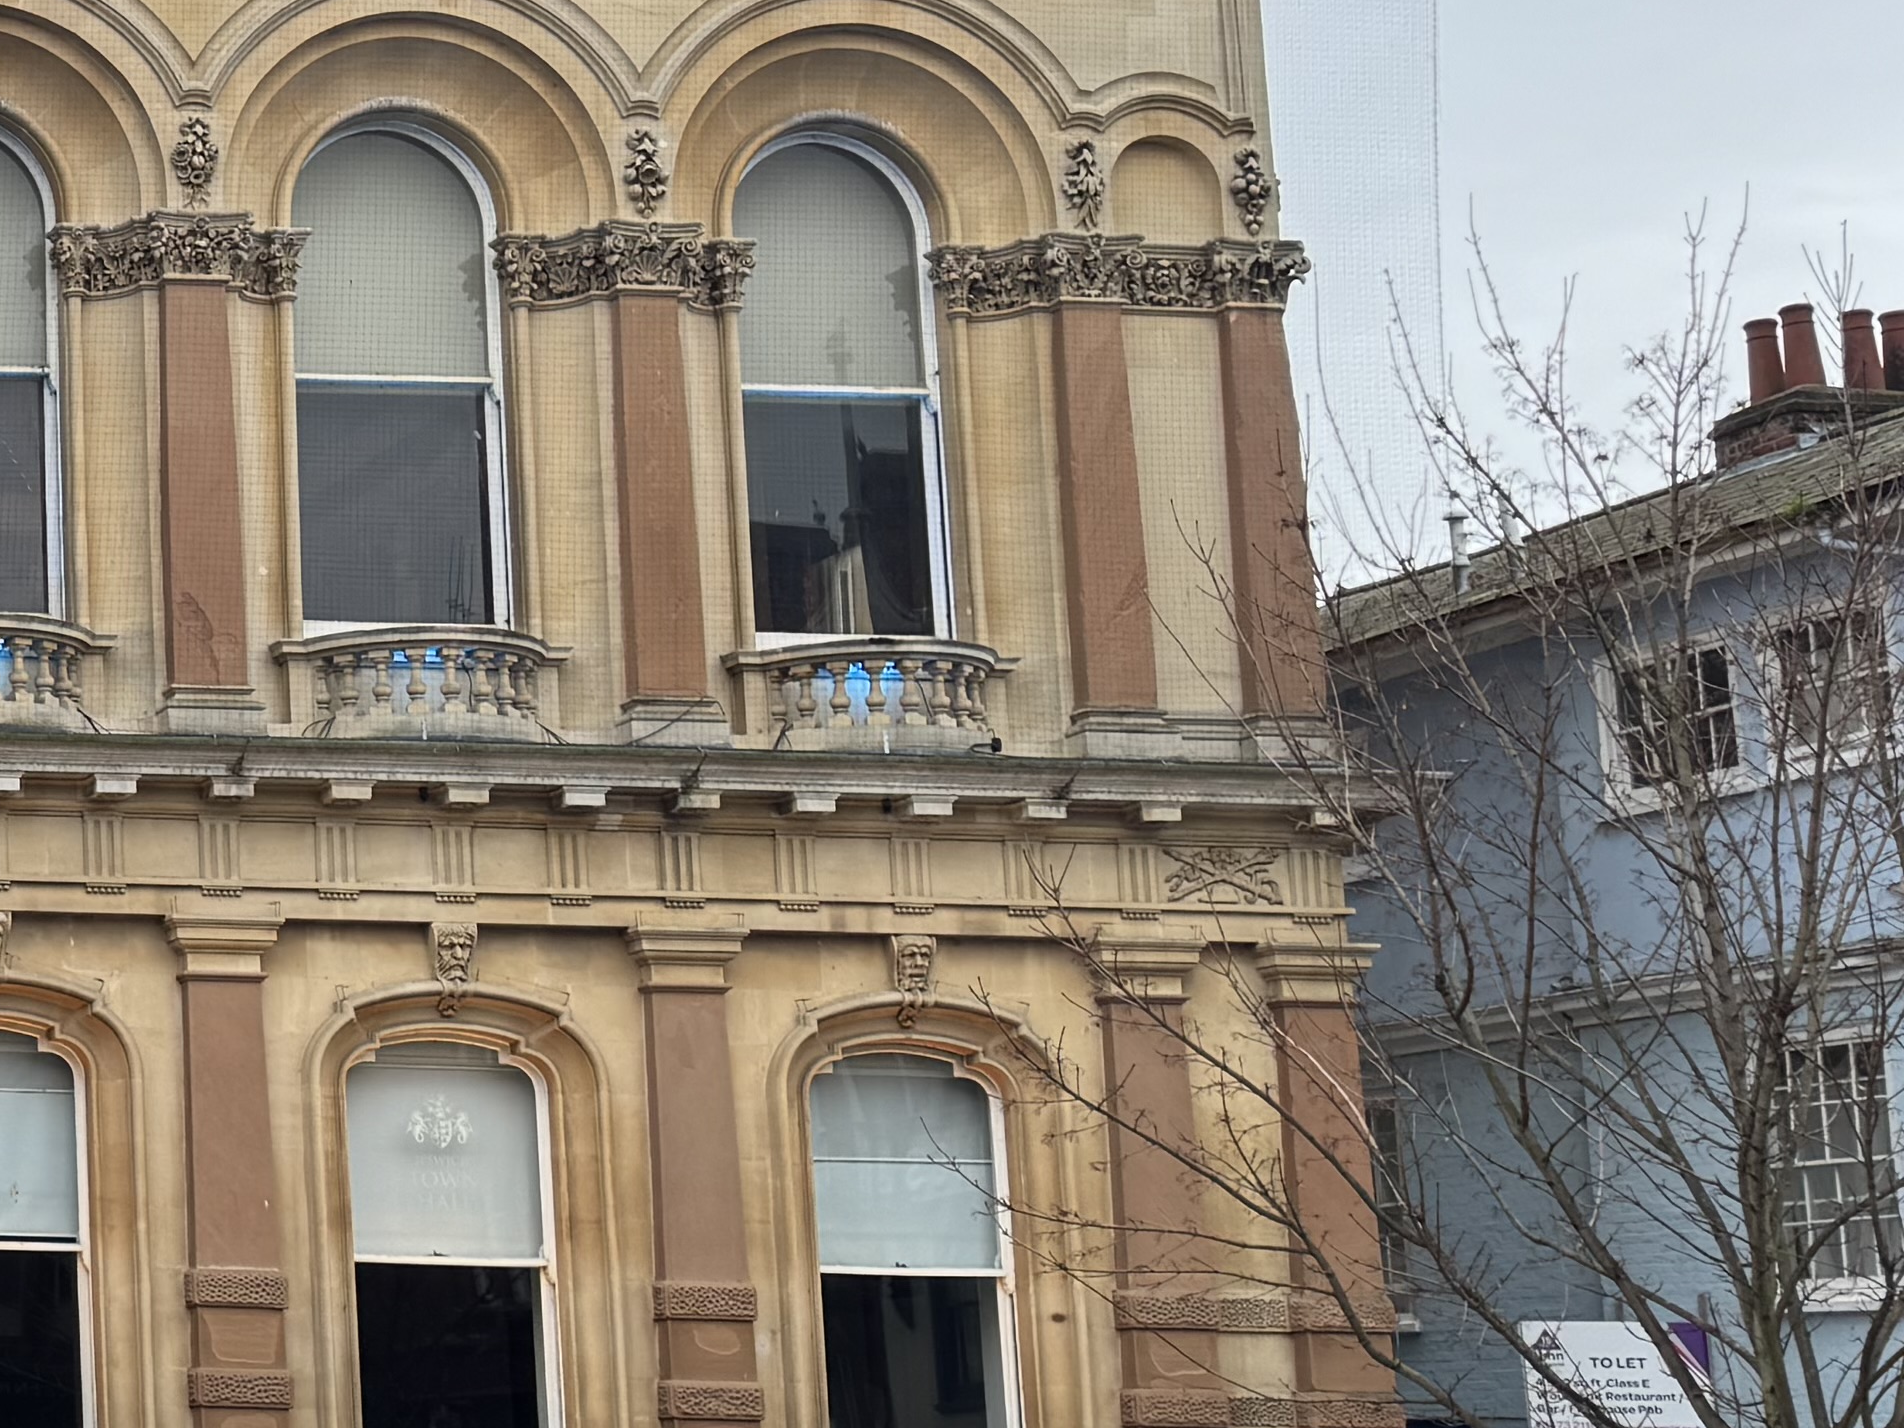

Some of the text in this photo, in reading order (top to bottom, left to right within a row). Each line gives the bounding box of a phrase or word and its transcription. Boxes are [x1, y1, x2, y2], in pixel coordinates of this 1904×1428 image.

[1588, 1357, 1648, 1369] TO LET
[1606, 1378, 1639, 1388] Class
[1641, 1379, 1651, 1389] E
[1605, 1392, 1676, 1402] Restaurant
